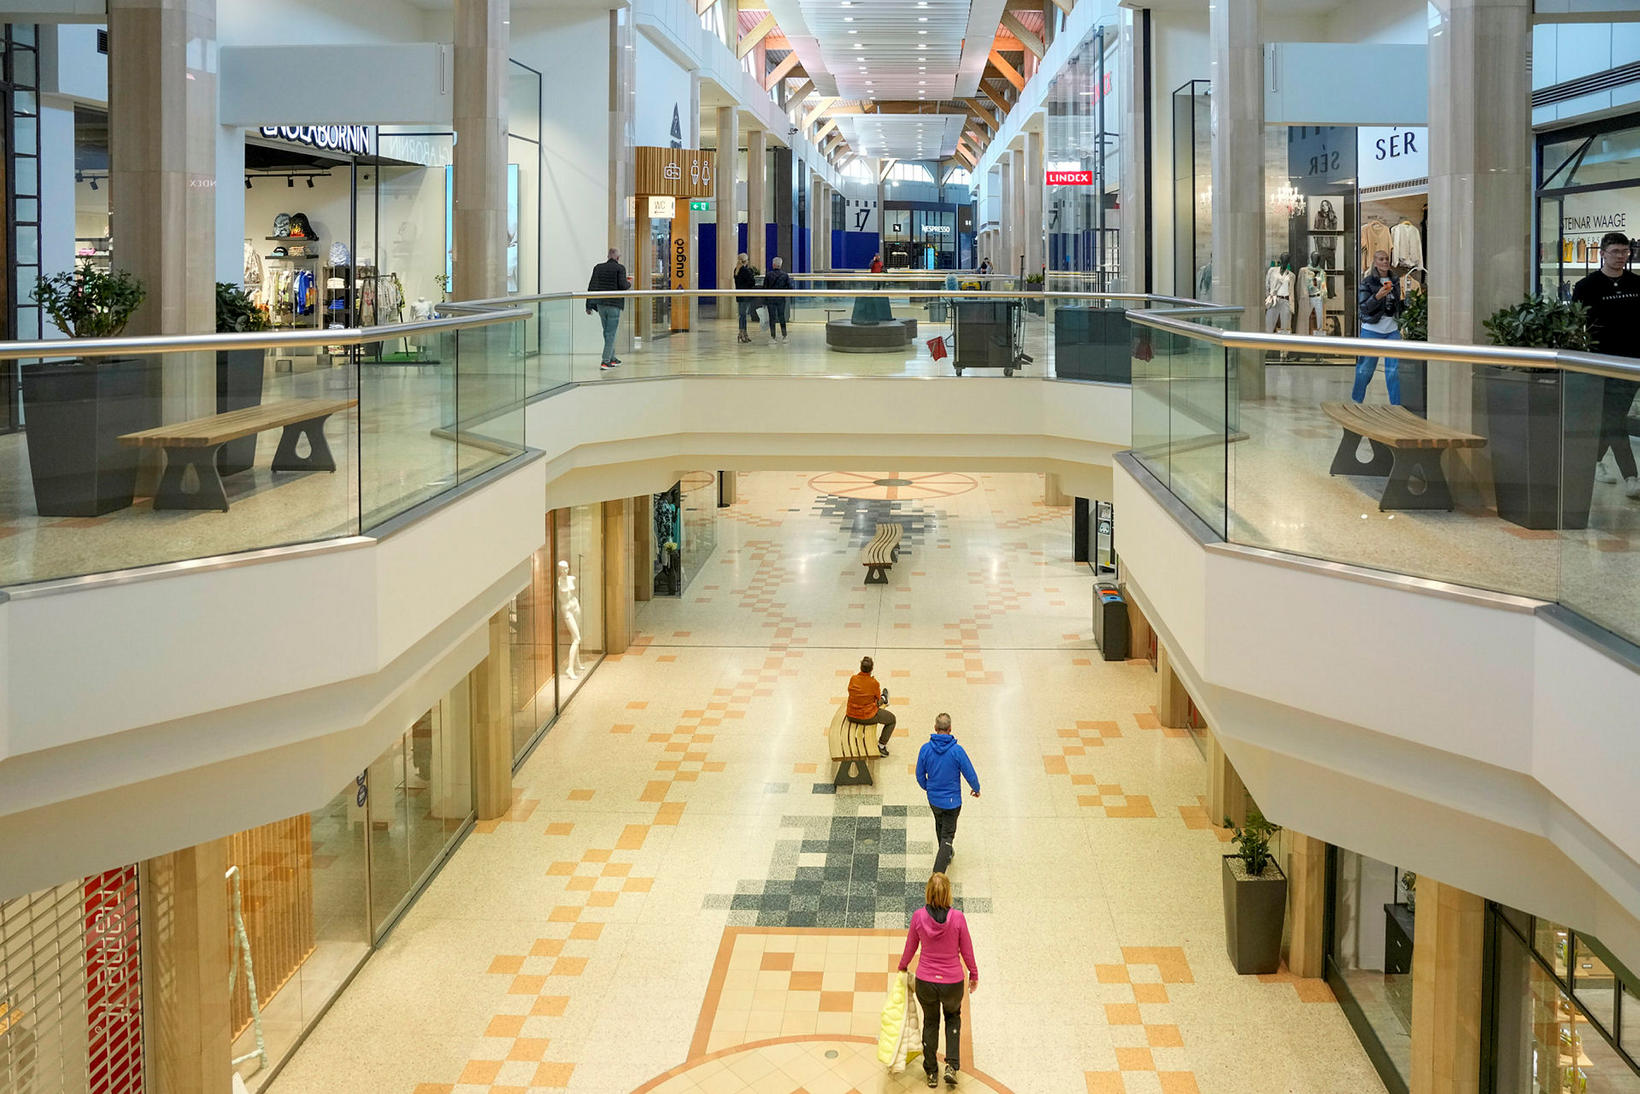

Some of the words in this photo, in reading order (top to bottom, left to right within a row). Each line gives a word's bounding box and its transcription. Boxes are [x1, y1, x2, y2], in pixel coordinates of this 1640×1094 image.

[1375, 127, 1418, 160] SÉR
[1049, 173, 1088, 182] LINDEX
[855, 209, 871, 231] 17
[921, 224, 951, 233] NESPRESSO
[1562, 215, 1590, 230] TEINAR
[1593, 213, 1626, 228] WAAGE
[674, 238, 687, 278] augað
